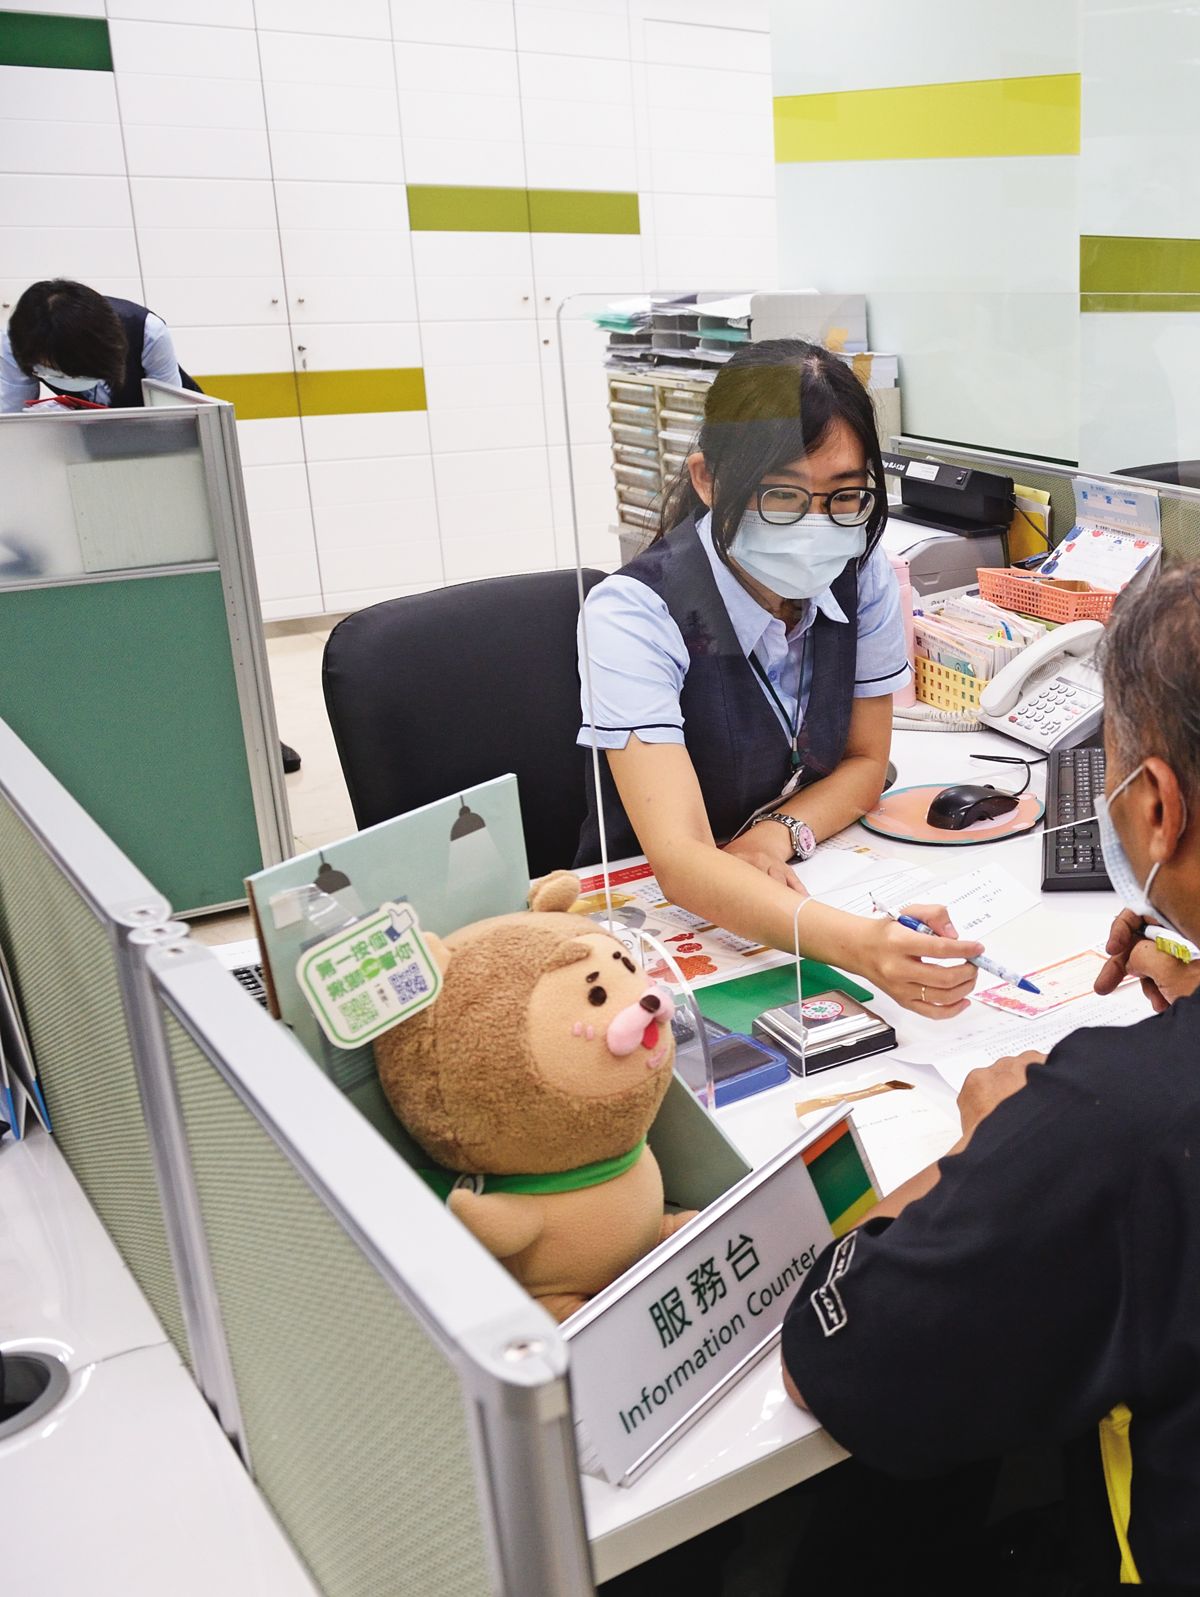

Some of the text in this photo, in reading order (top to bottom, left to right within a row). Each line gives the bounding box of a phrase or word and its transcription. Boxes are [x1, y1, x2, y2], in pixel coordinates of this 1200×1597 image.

[618, 1244, 818, 1434] Information Counter
[648, 1233, 760, 1349] 服務台
